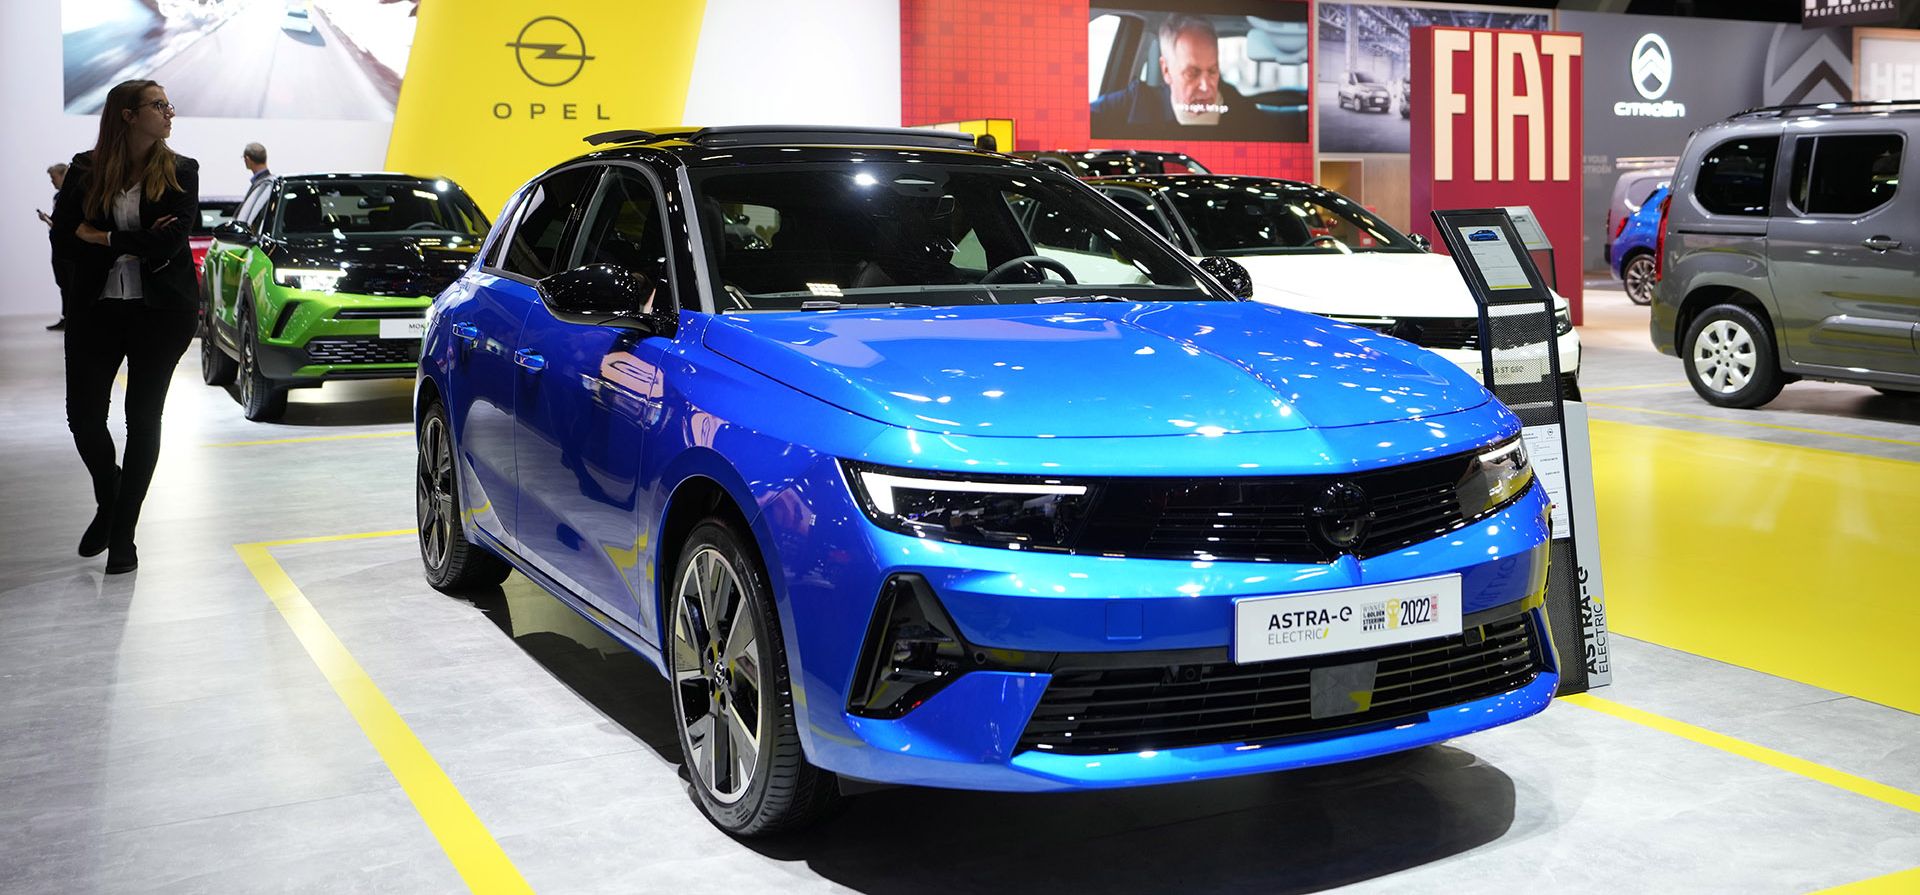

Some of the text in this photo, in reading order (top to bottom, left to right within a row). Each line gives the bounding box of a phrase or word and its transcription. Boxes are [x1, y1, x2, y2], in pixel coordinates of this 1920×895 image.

[1804, 1, 1895, 18] PROFESSIONAL
[493, 102, 610, 120] OPEL
[1434, 29, 1582, 181] FIAT
[1401, 597, 1430, 626] 2022
[1268, 628, 1323, 645] ELECTRIC
[1593, 603, 1609, 674] ELECTRIC
